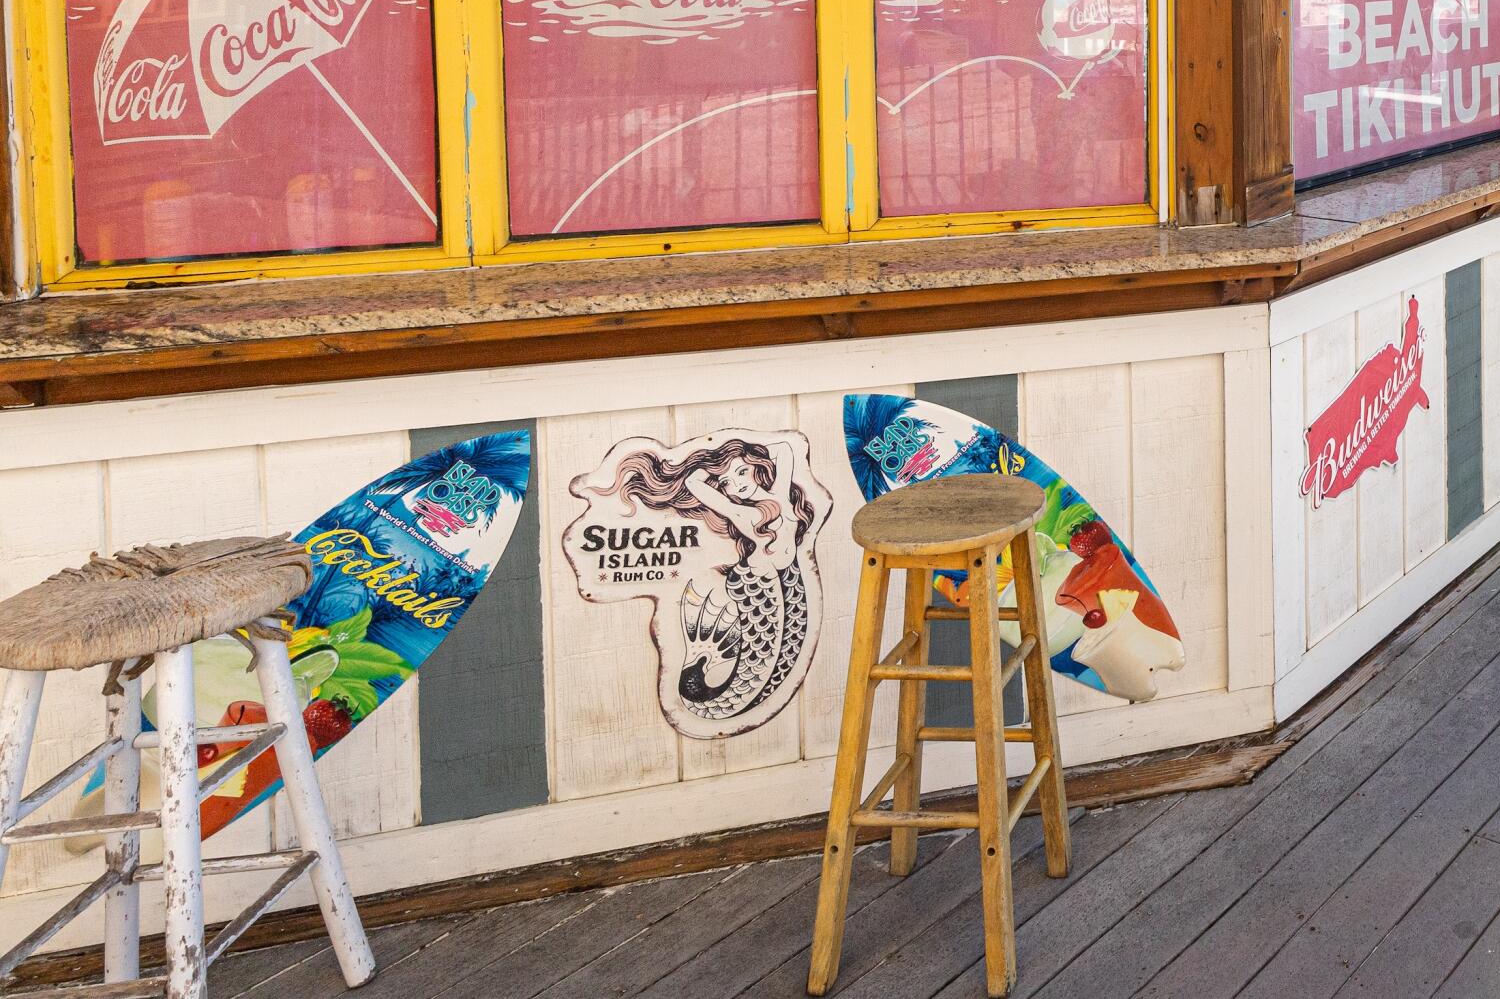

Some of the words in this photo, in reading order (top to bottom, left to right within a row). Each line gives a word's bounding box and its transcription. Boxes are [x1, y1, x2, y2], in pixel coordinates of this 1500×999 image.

[108, 52, 189, 123] Cola
[1303, 78, 1406, 159] TIKI
[864, 416, 914, 461] ISLAND
[1300, 328, 1426, 510] Budweiser
[881, 427, 930, 472] OASIS
[941, 452, 962, 470] Frozen
[1342, 442, 1368, 479] BREWING
[1366, 436, 1373, 447] A
[1370, 410, 1390, 441] BETTER
[426, 479, 487, 524] OASIS
[443, 459, 501, 507] ISLAND
[365, 500, 377, 512] The
[380, 509, 407, 530] World's
[407, 526, 428, 545] Finest
[429, 541, 453, 561] Frozen
[580, 525, 699, 552] SUGAR
[306, 519, 464, 629] Cocktails
[598, 551, 681, 569] ISLAND
[613, 571, 643, 583] RUM
